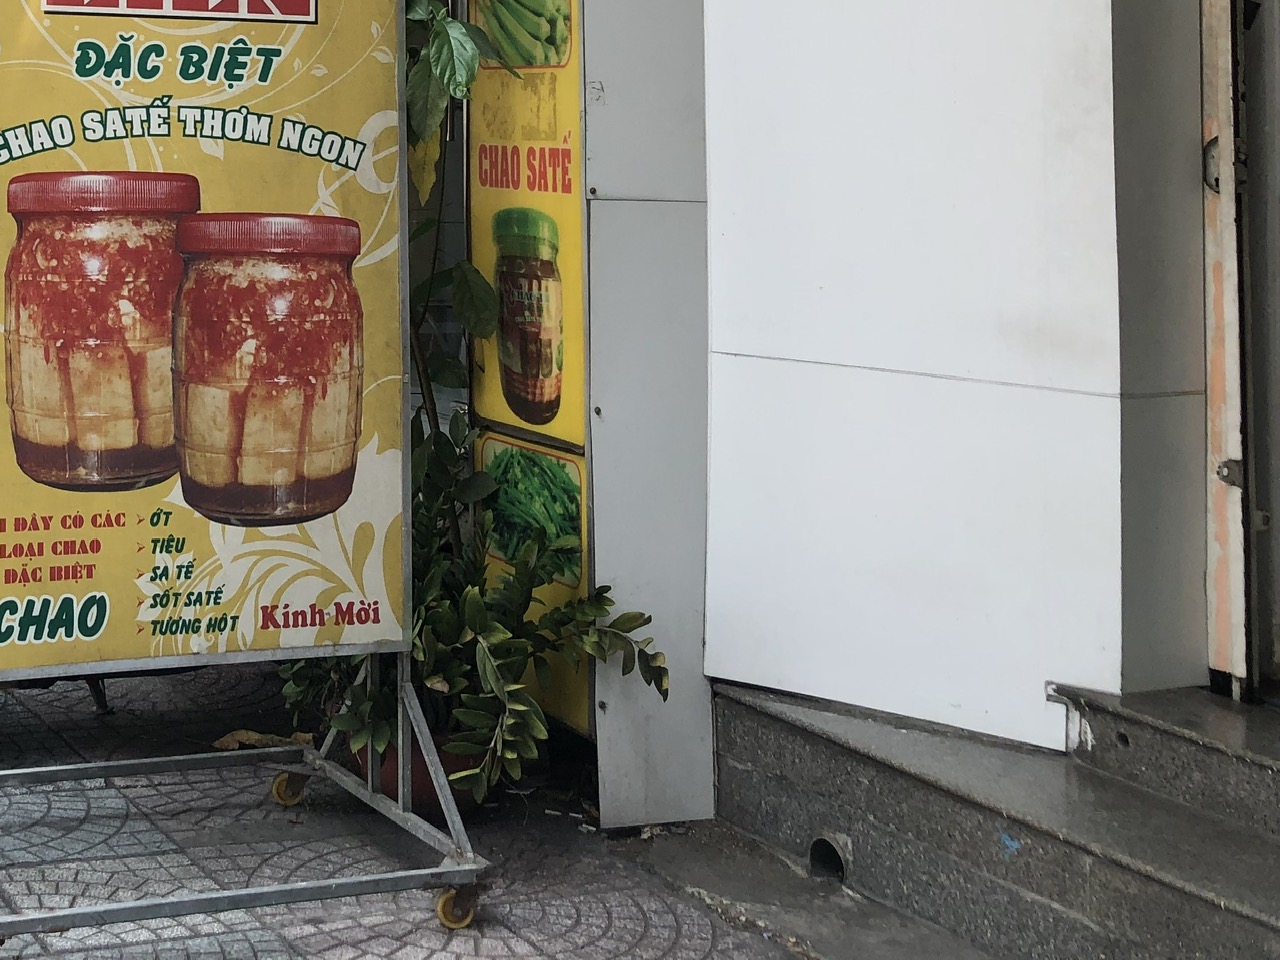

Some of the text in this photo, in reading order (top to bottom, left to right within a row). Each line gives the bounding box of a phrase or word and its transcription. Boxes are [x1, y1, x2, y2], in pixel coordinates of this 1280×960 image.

[74, 33, 283, 90] ĐẶC BIỆT
[81, 95, 174, 140] SATẾ
[178, 105, 275, 145] THƠM
[277, 121, 366, 171] NGON
[478, 130, 572, 194] CHAO SATẾ
[60, 511, 84, 530] CÓ
[90, 509, 126, 528] CÁC
[149, 507, 172, 527] ỚT
[0, 535, 186, 561] LOẠI CHAO TIÊU
[4, 558, 196, 587] ĐẶC BIỆT SA TẾ
[150, 587, 181, 609] SỐT
[151, 599, 381, 636] TƯƠNG HỘT Kính Mời
